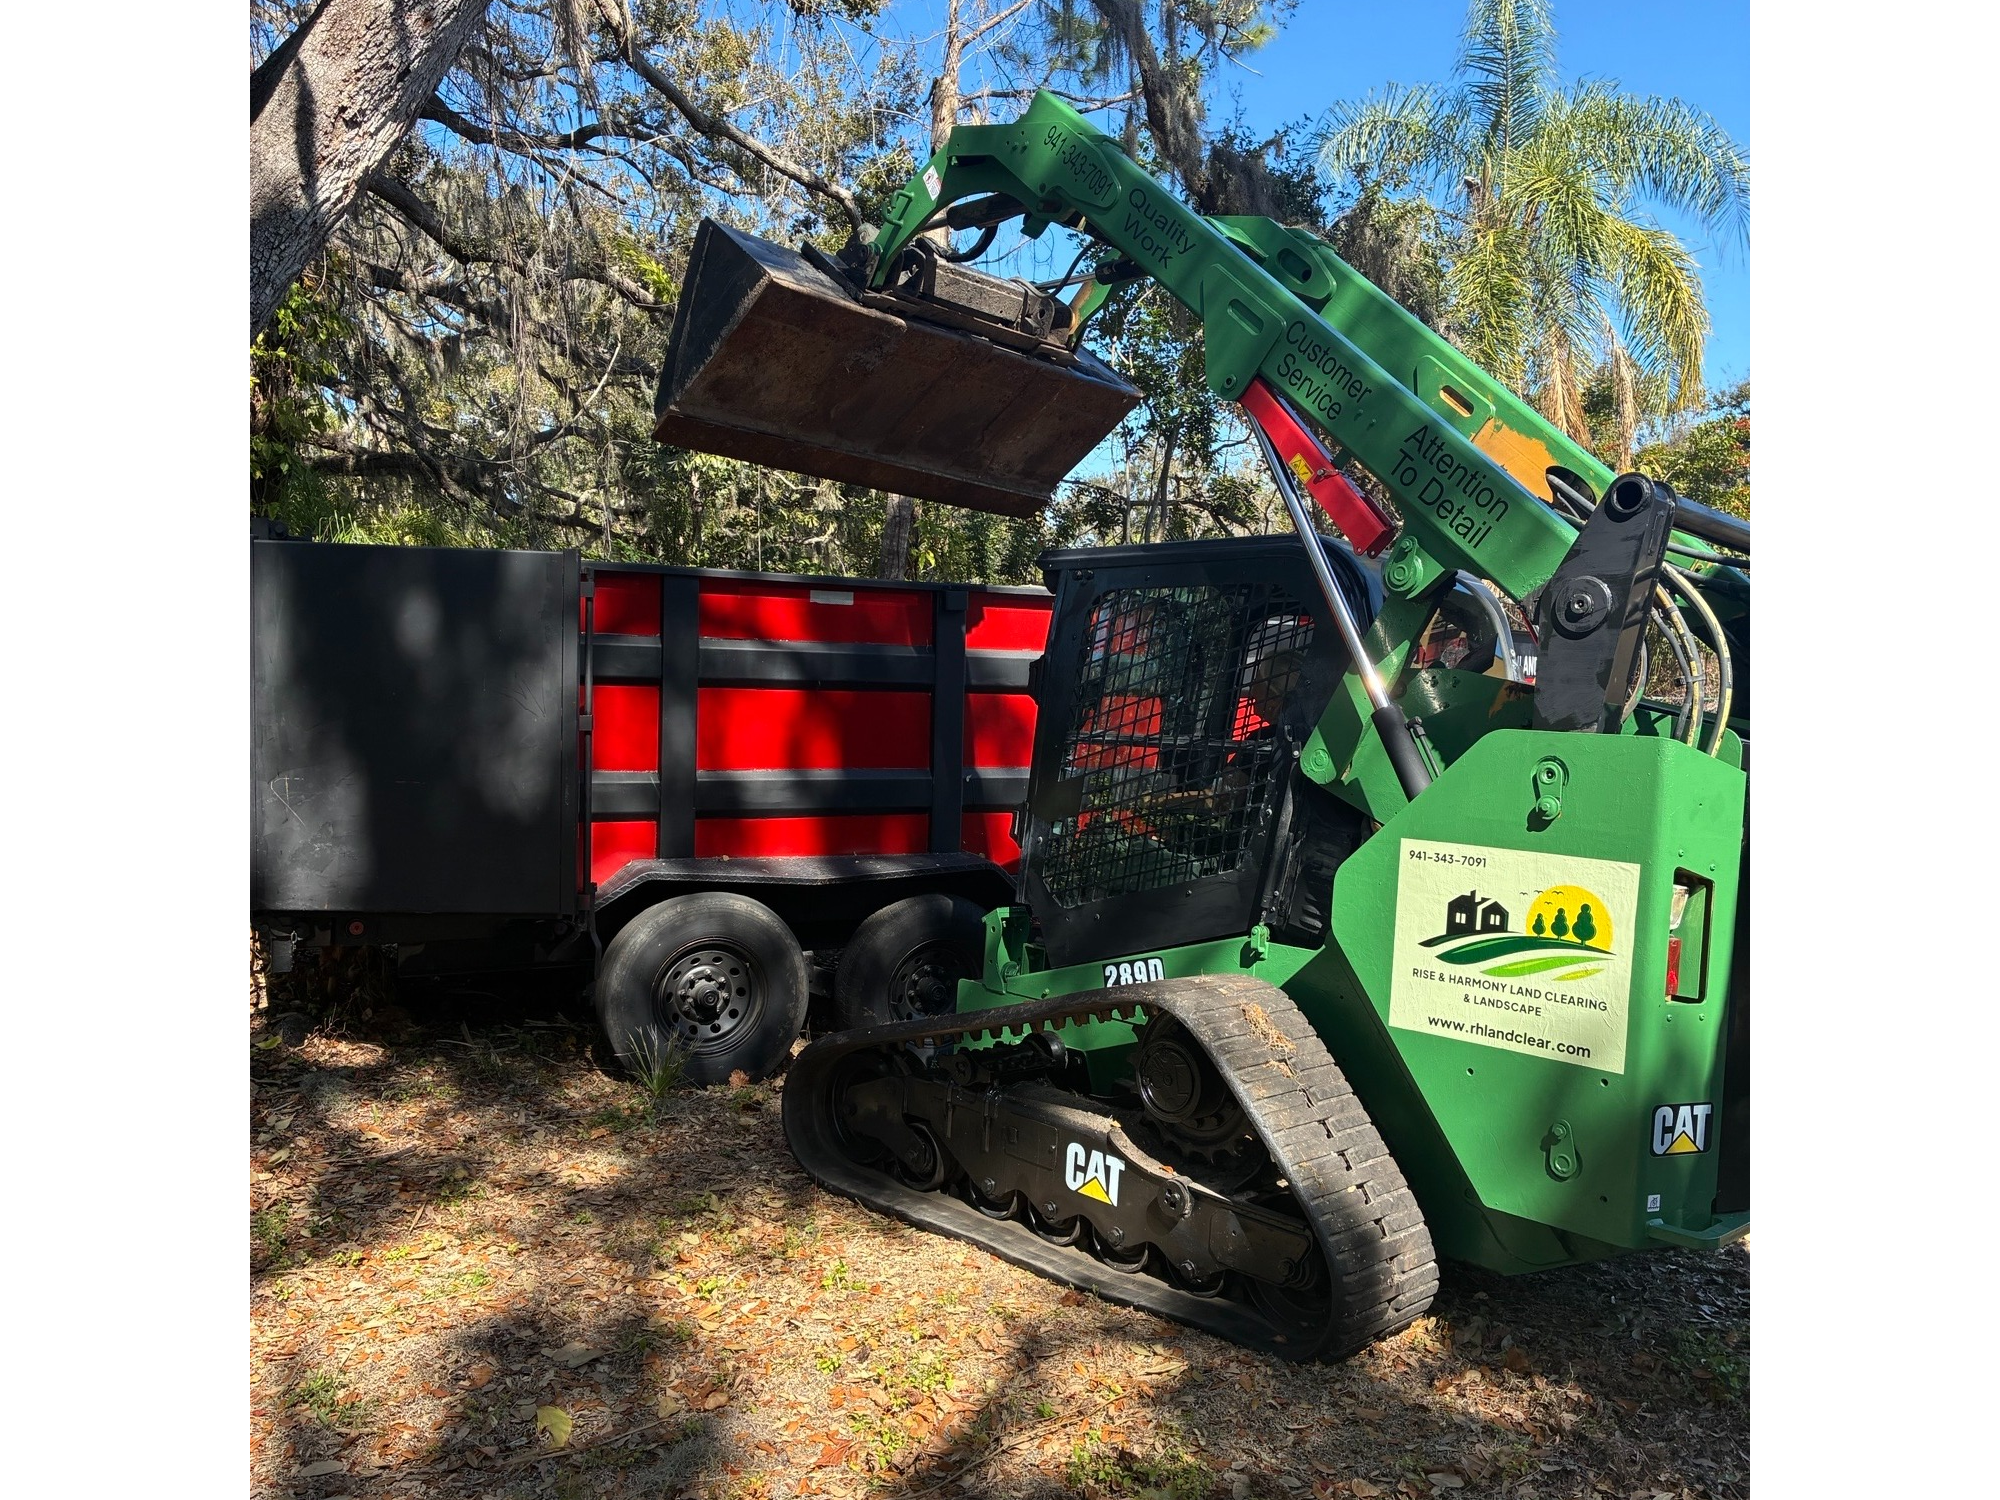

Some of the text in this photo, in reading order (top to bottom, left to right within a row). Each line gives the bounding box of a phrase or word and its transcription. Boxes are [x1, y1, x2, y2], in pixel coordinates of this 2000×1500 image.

[1043, 125, 1113, 202] 941-343-7091
[1123, 212, 1173, 270] Work
[1128, 187, 1197, 256] Quality
[1276, 353, 1342, 421] Service
[1286, 320, 1373, 404] Customer
[1390, 448, 1493, 549] To Detail
[1404, 424, 1510, 523] Attention
[1408, 849, 1487, 867] 941-343-7091
[1104, 958, 1165, 988] 289D
[1412, 967, 1607, 1011] RISE & HARMONY LAND CLEARING
[1463, 993, 1541, 1015] & LANDSCAPE
[1427, 1015, 1591, 1058] www.rhlandclear.com
[1652, 1103, 1711, 1154] CAT
[1065, 1141, 1125, 1207] CAT
